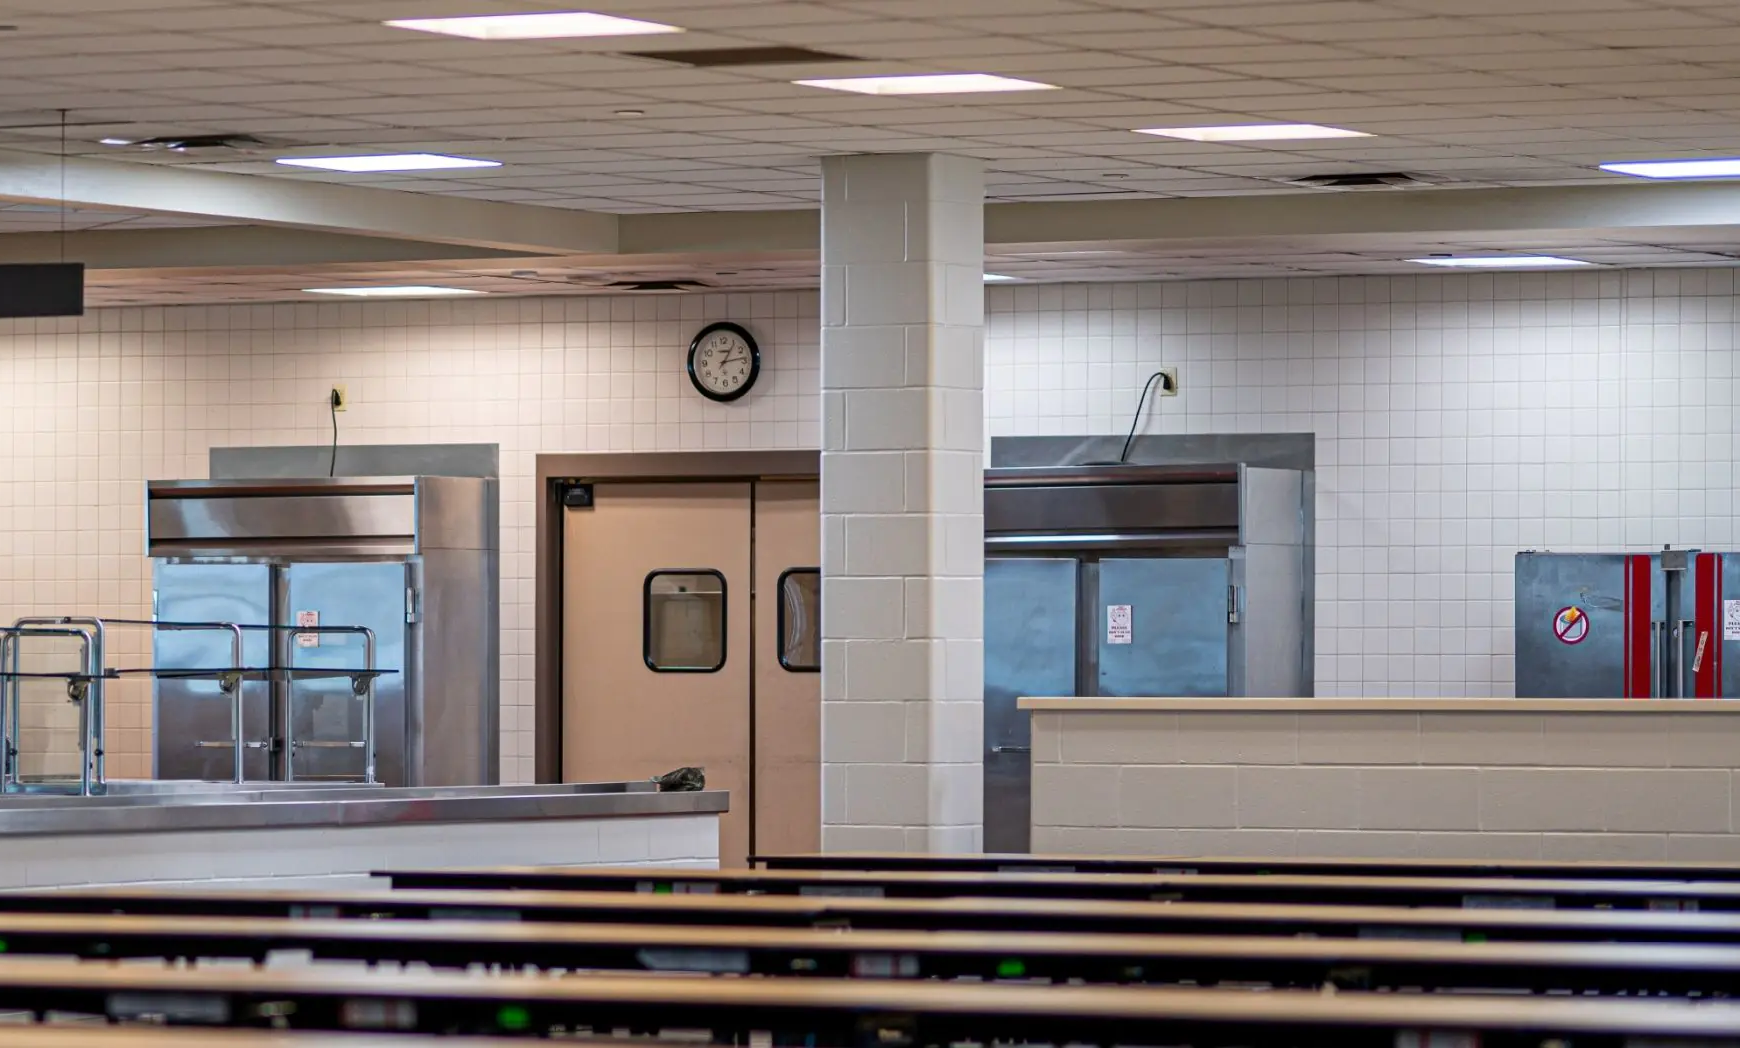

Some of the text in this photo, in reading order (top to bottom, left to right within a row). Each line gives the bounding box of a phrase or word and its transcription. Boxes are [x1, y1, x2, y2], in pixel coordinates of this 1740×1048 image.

[711, 340, 718, 348] 11
[720, 336, 728, 344] 12
[704, 349, 713, 357] 10
[738, 346, 744, 354] 2
[701, 359, 708, 367] 9
[739, 367, 745, 375] 4
[713, 376, 718, 384] 7
[722, 379, 729, 387] 6
